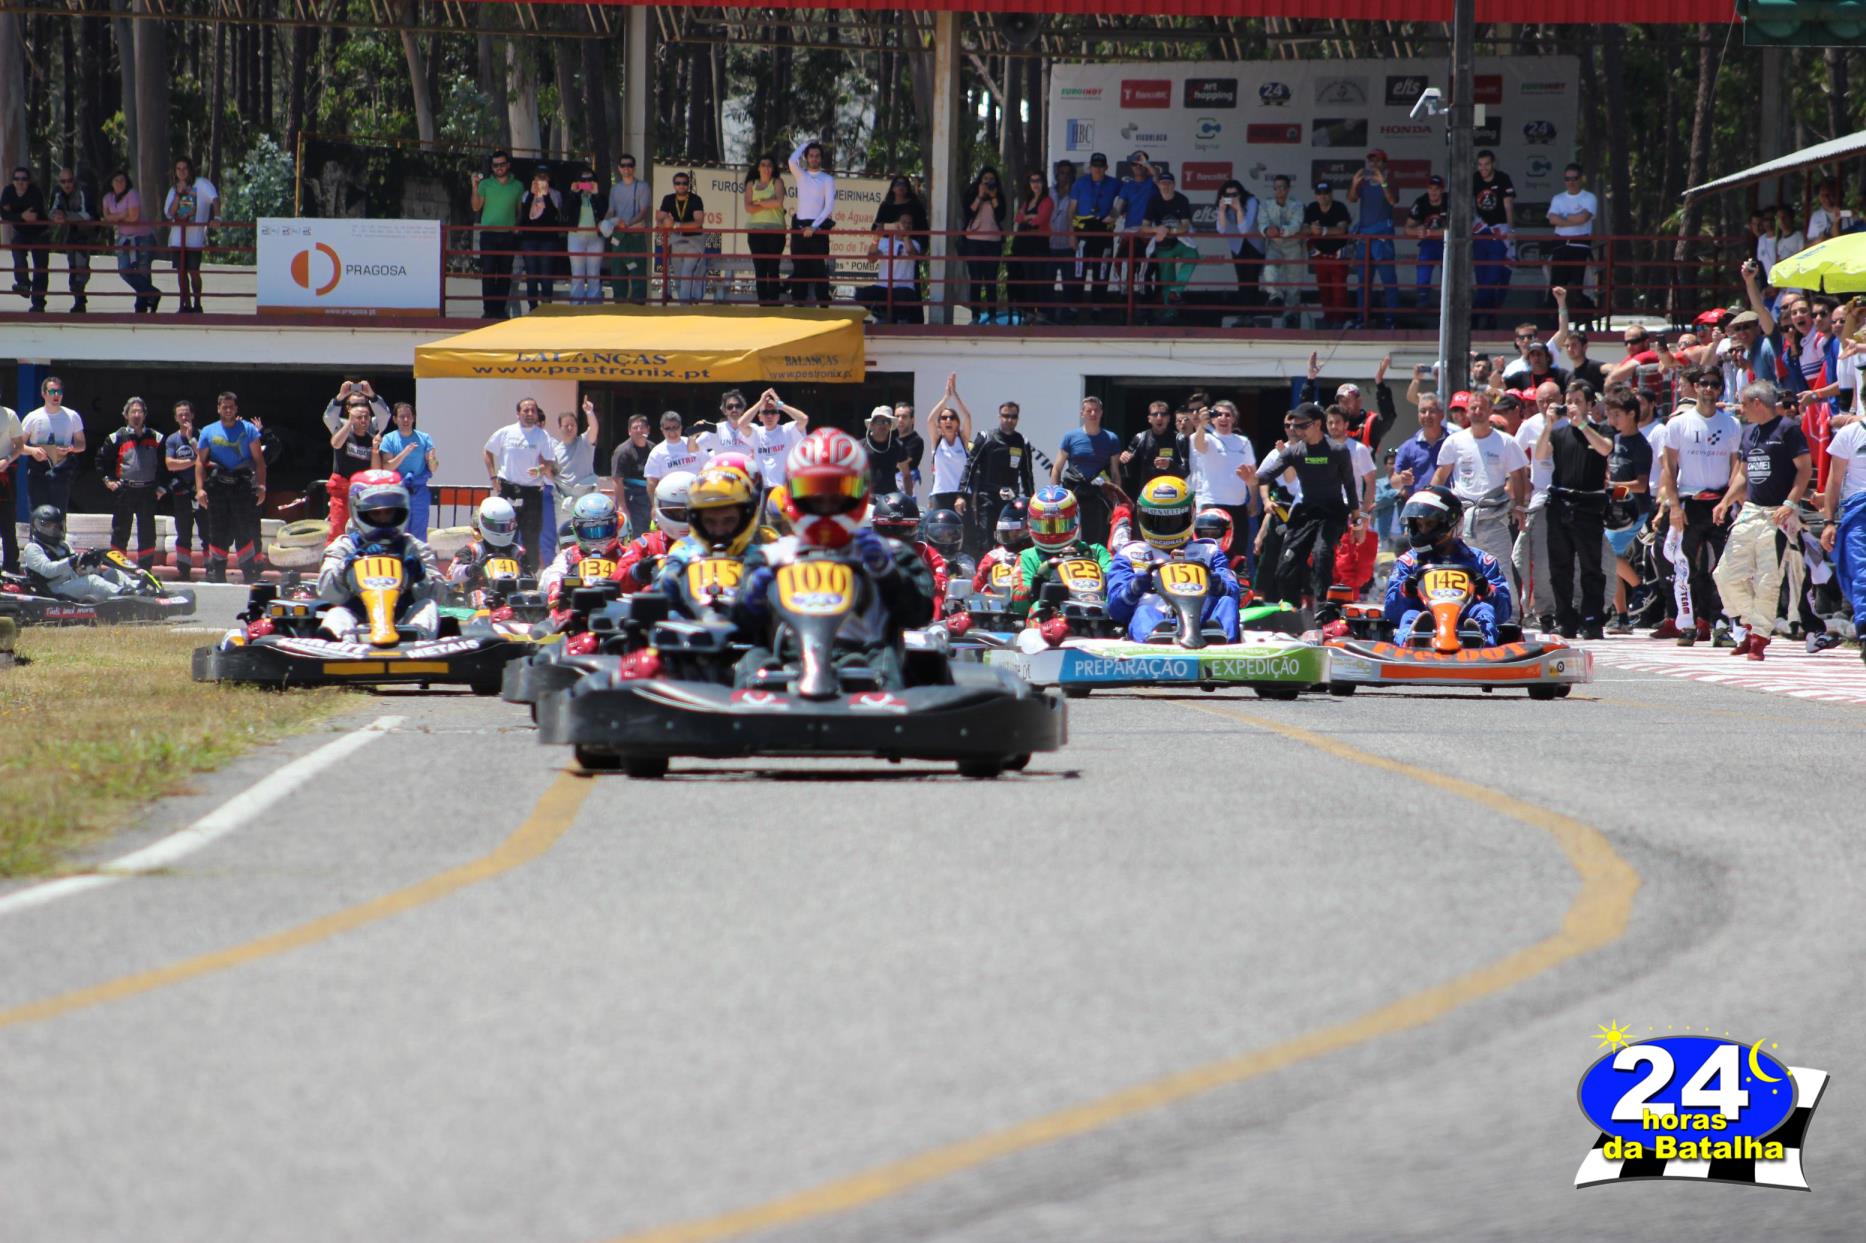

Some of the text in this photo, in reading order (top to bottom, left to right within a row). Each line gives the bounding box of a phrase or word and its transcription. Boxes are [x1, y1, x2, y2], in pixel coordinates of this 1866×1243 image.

[1379, 125, 1432, 134] HONDA
[345, 264, 407, 277] PRAGOSA
[667, 456, 697, 469] UNITRIP
[582, 562, 613, 578] 134
[789, 562, 848, 593] 100
[1063, 560, 1101, 579] 123
[1169, 564, 1201, 584] 151
[1432, 570, 1467, 590] 142
[406, 637, 480, 659] METAIS
[1075, 655, 1300, 679] PREPARAÇÃO EXPEDIÇÃO
